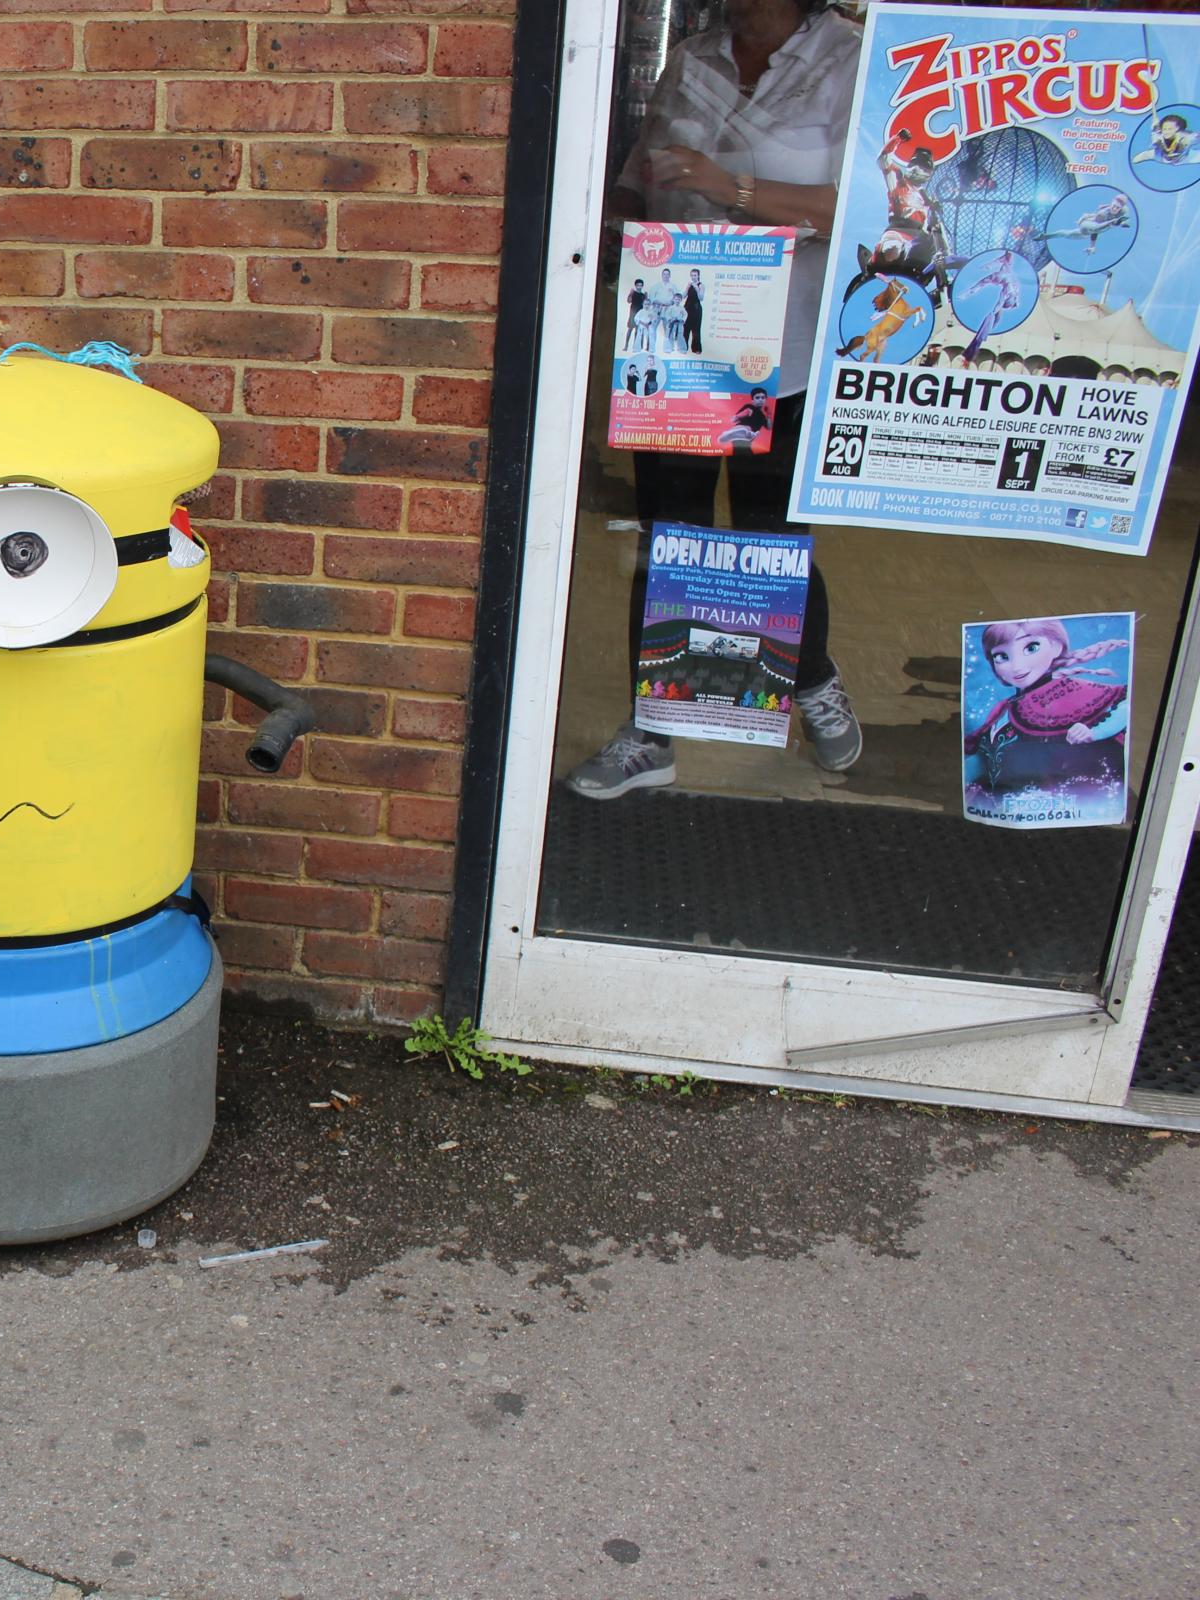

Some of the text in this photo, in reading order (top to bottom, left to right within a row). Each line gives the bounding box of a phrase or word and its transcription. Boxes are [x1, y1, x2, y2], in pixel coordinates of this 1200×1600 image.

[887, 60, 1157, 163] CIRCUS
[1074, 118, 1120, 130] Featuring
[1062, 129, 1127, 141] the incredible
[1074, 141, 1109, 151] GLOBE
[1084, 153, 1095, 162] of
[1066, 163, 1107, 174] TERROR
[678, 239, 776, 257] KARATE & KICKBOXING
[749, 355, 769, 363] CLASSES
[834, 367, 1138, 417] BRIGHTON HOVE
[616, 399, 667, 410] PAY-AS-YOU-GO
[1076, 404, 1149, 426] LAWNS
[831, 406, 1145, 444] KINGSWAY, BY KING ALFRED LEISURE CENTRE BN3 2WW
[834, 424, 862, 436] FROM
[614, 431, 712, 448] SAMAMARTIALARTS.CO.UK
[1011, 438, 1040, 450] UNTIL
[826, 436, 863, 465] 20
[1055, 452, 1085, 462] FROM
[1058, 442, 1136, 468] TICKETS £7
[830, 465, 852, 476] AUG
[1015, 451, 1030, 479] 1
[1004, 478, 1031, 490] SEPT
[810, 487, 881, 511] BOOK NOW!
[884, 492, 1063, 516] WWW.ZIPPOSCIRCUS.CO.UK
[1041, 487, 1130, 504] CIRCUS CAR-PARKING NEARBY
[883, 503, 1061, 526] PHONE BOOKINGS 0871 210 2100
[666, 528, 682, 536] THE
[683, 530, 697, 539] BIG
[724, 534, 759, 545] PROJECT
[760, 538, 799, 548] PRESENTS
[652, 535, 809, 578] OPEN AIR CINEMA
[651, 564, 684, 574] Centenary
[669, 572, 789, 593] Saturday 19th September
[685, 593, 701, 601] Film
[702, 595, 721, 603] starts
[687, 584, 764, 602] Doors Open 7pm
[652, 600, 801, 631] THE ITALIAN JOB
[707, 693, 736, 702] POWERED
